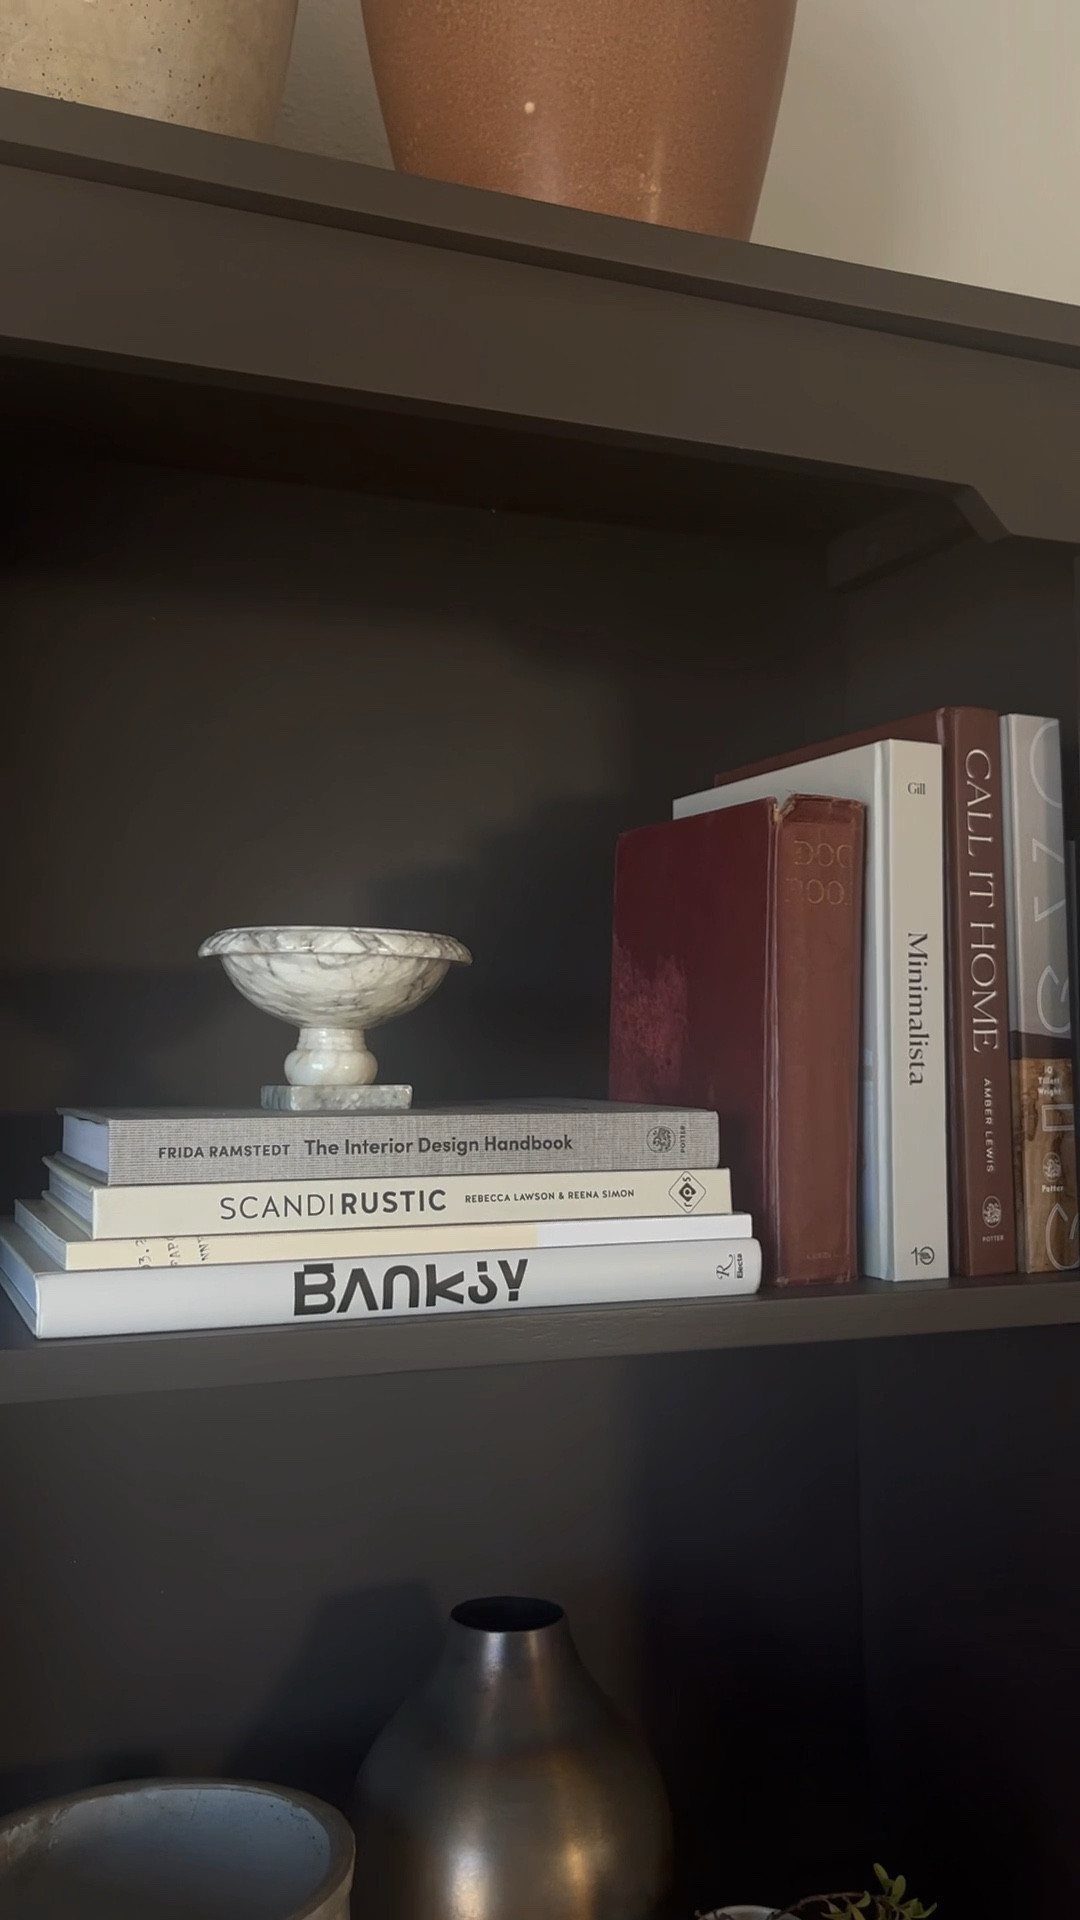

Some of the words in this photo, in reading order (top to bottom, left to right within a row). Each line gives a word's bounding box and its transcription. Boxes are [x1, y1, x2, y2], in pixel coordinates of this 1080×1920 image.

[907, 782, 926, 795] Gill
[965, 748, 994, 856] CALL
[969, 870, 995, 908] IT
[970, 921, 999, 1052] HOME
[907, 931, 930, 1086] Minimalista
[983, 1078, 994, 1125] AMBER
[1038, 1087, 1061, 1097] Wright
[158, 1146, 205, 1159] FRIDA
[209, 1144, 291, 1158] RAMSTEDT
[304, 1139, 339, 1156] The
[345, 1137, 413, 1155] Interior
[419, 1136, 479, 1156] Design
[485, 1134, 573, 1152] Handbook
[985, 1131, 995, 1173] LEWIS
[465, 1193, 511, 1204] REBECCA
[514, 1191, 555, 1202] LAWSON
[558, 1191, 565, 1200] &
[568, 1190, 599, 1200] REENA
[602, 1189, 635, 1199] SIMON
[1042, 1184, 1064, 1193] Potter
[982, 1234, 1004, 1243] POTTER
[736, 1253, 744, 1279] Electa
